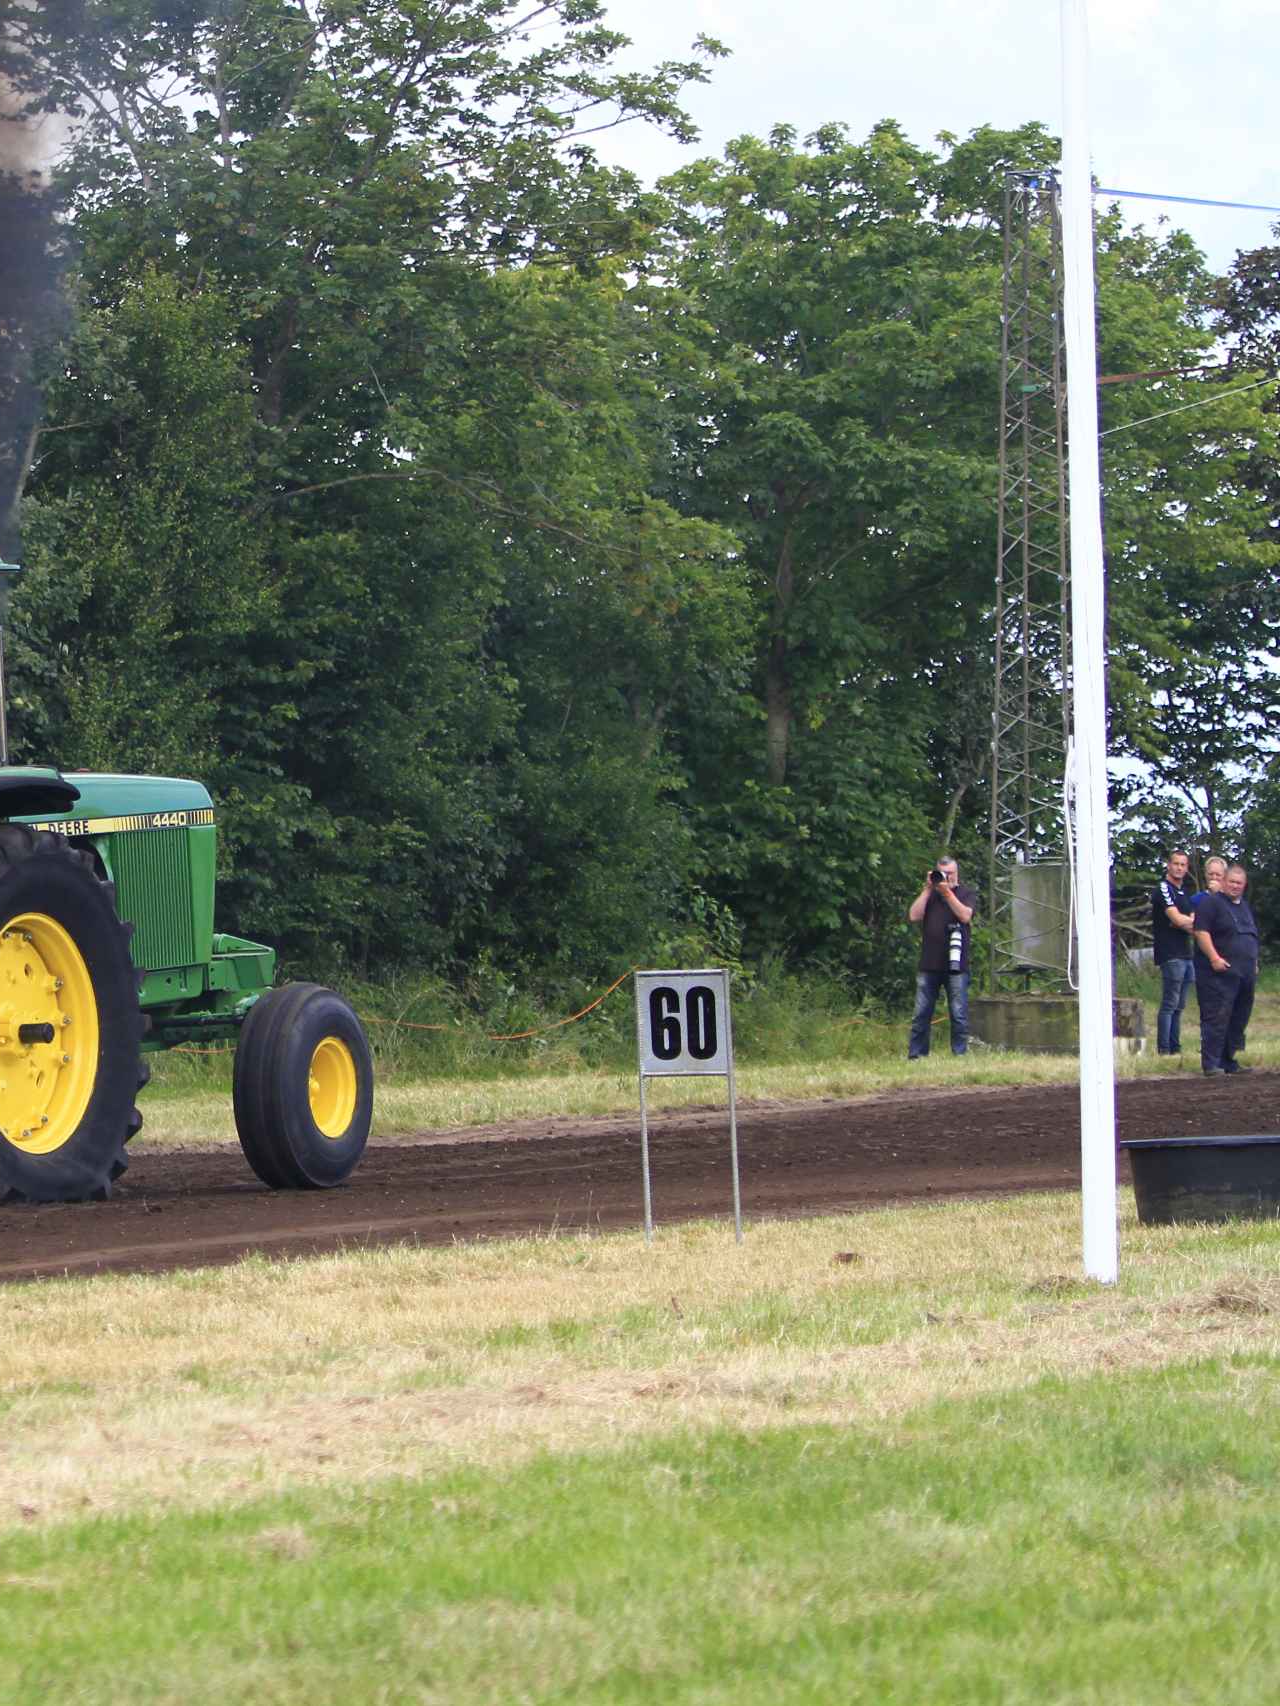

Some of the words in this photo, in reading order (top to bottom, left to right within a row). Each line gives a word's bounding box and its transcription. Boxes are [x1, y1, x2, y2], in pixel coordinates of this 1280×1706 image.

[48, 820, 89, 834] DEERE
[153, 811, 187, 828] 4440
[649, 986, 718, 1060] 60
